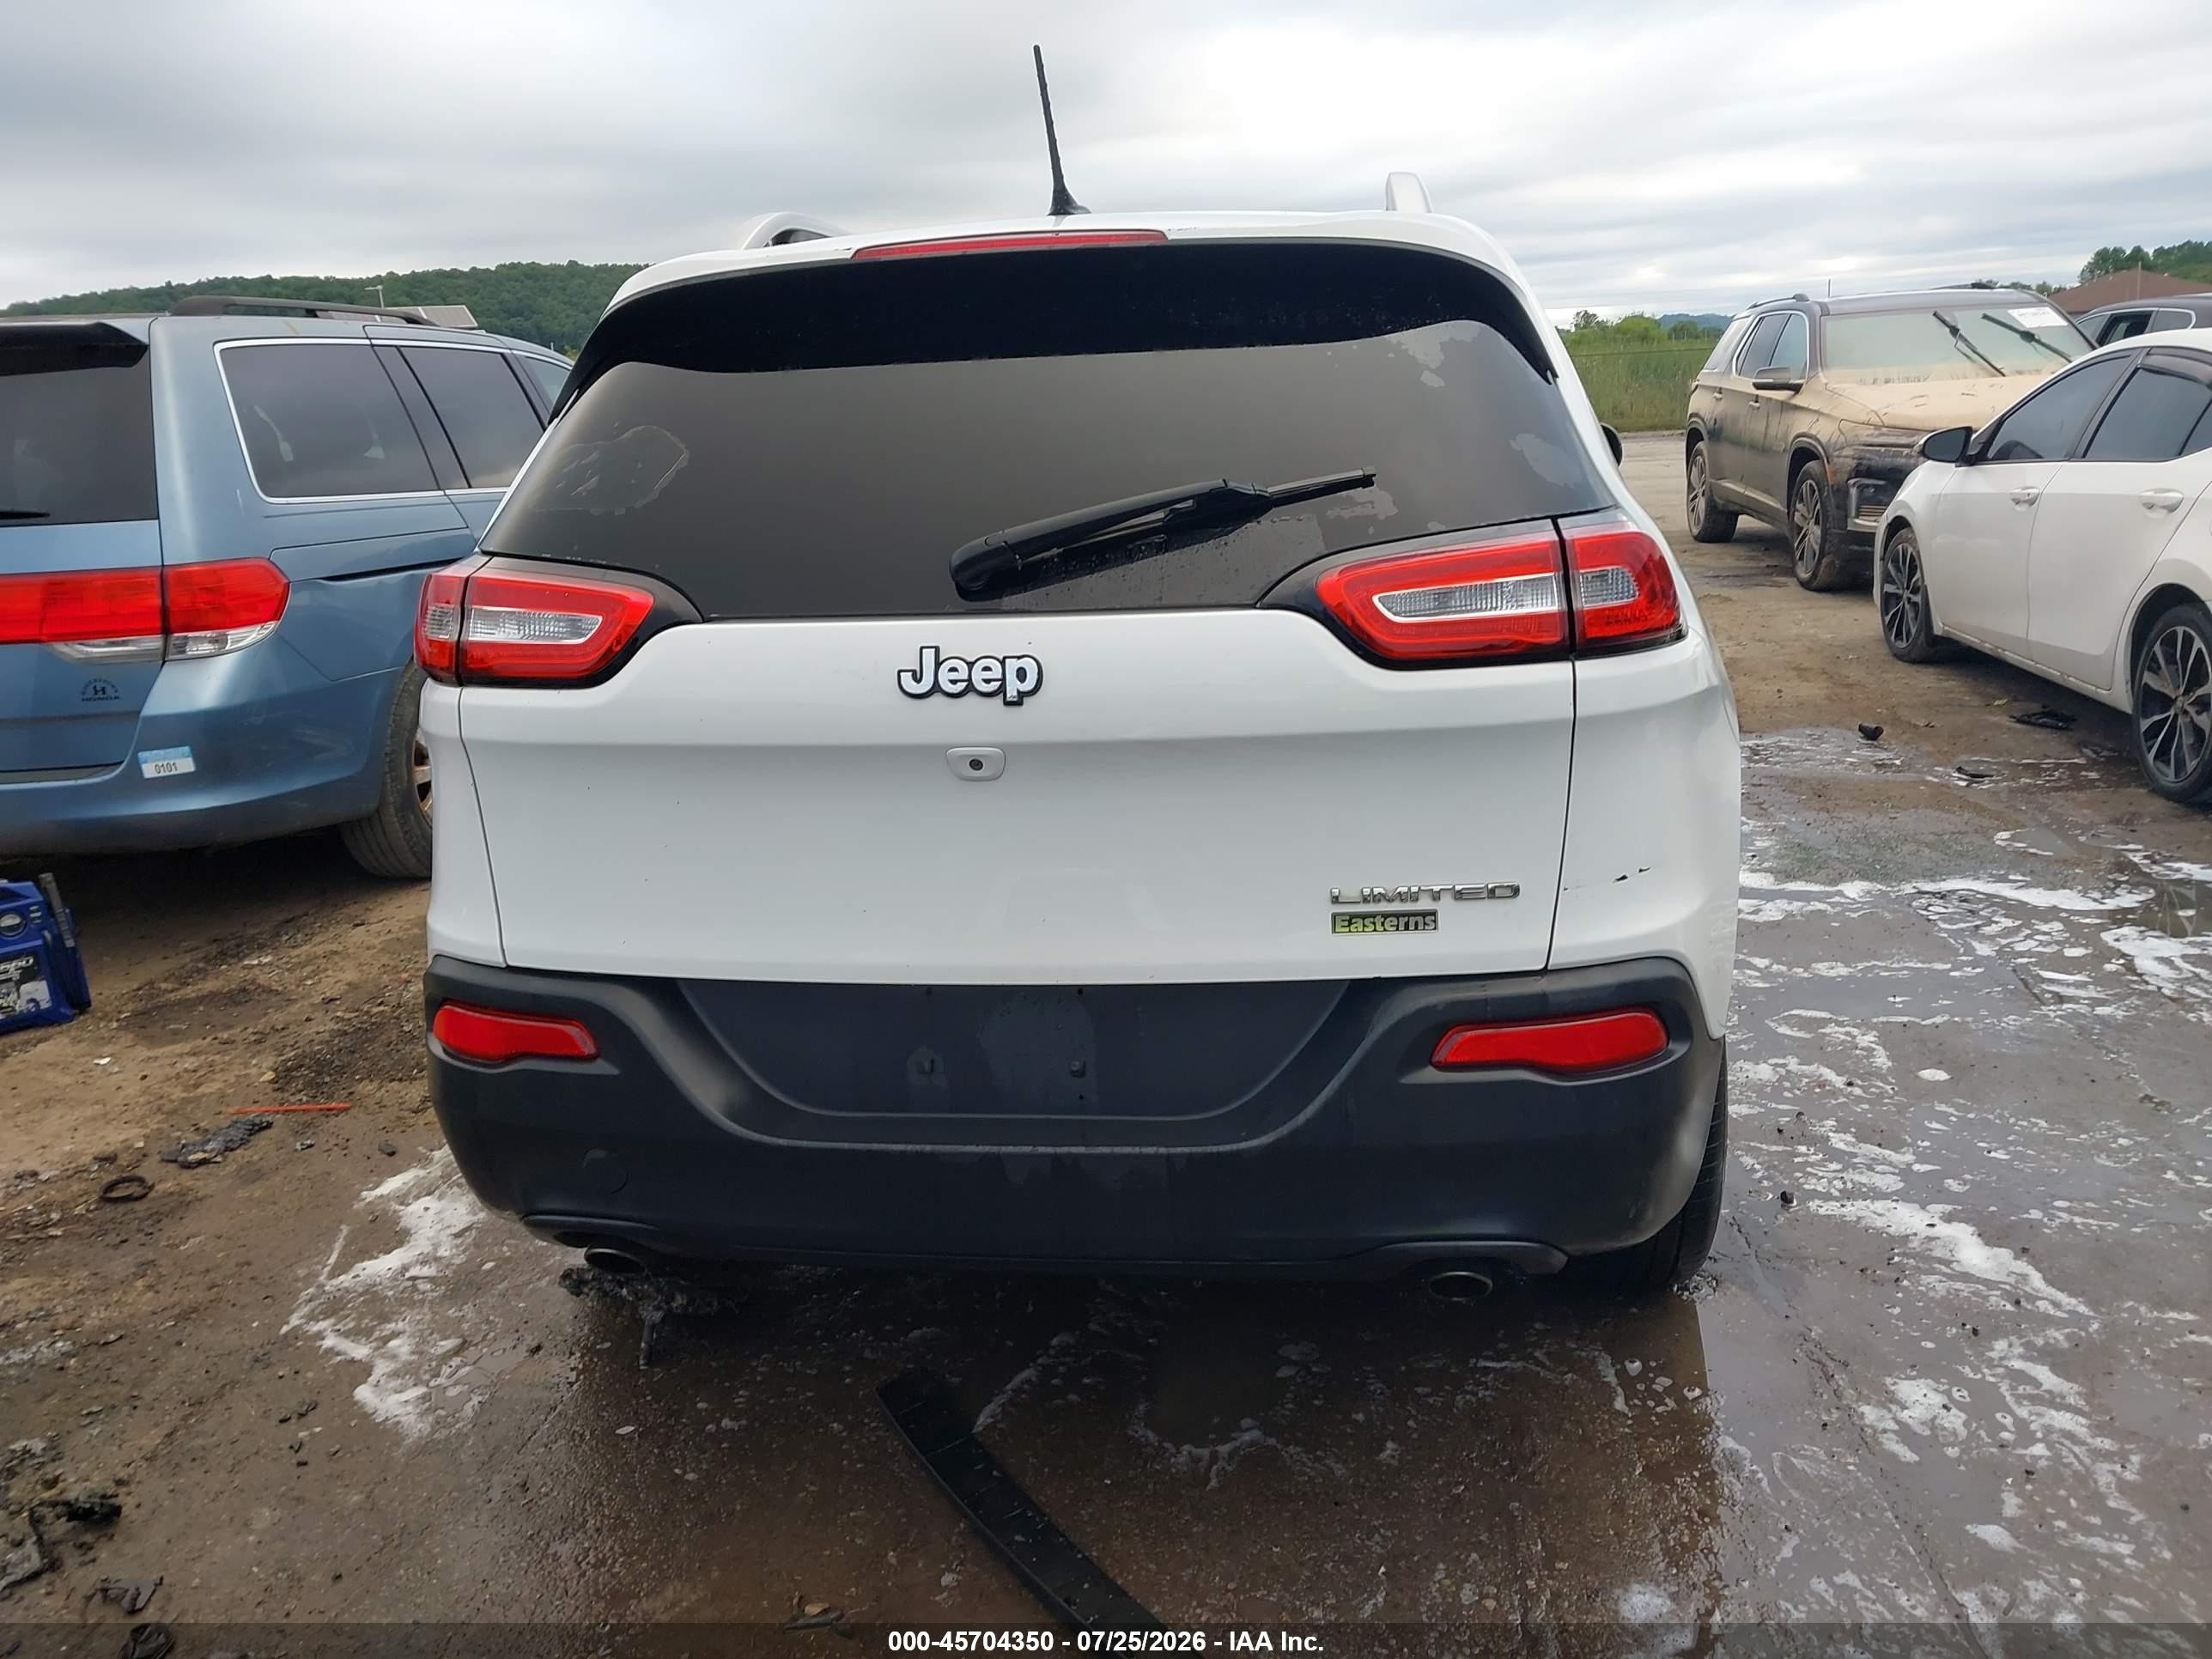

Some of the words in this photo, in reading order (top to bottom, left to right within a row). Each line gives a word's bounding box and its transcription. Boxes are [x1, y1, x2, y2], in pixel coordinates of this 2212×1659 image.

[897, 645, 1043, 706] Jeep
[154, 762, 179, 775] 0101
[1330, 882, 1521, 905] LIMITED
[1334, 915, 1436, 933] Easterns
